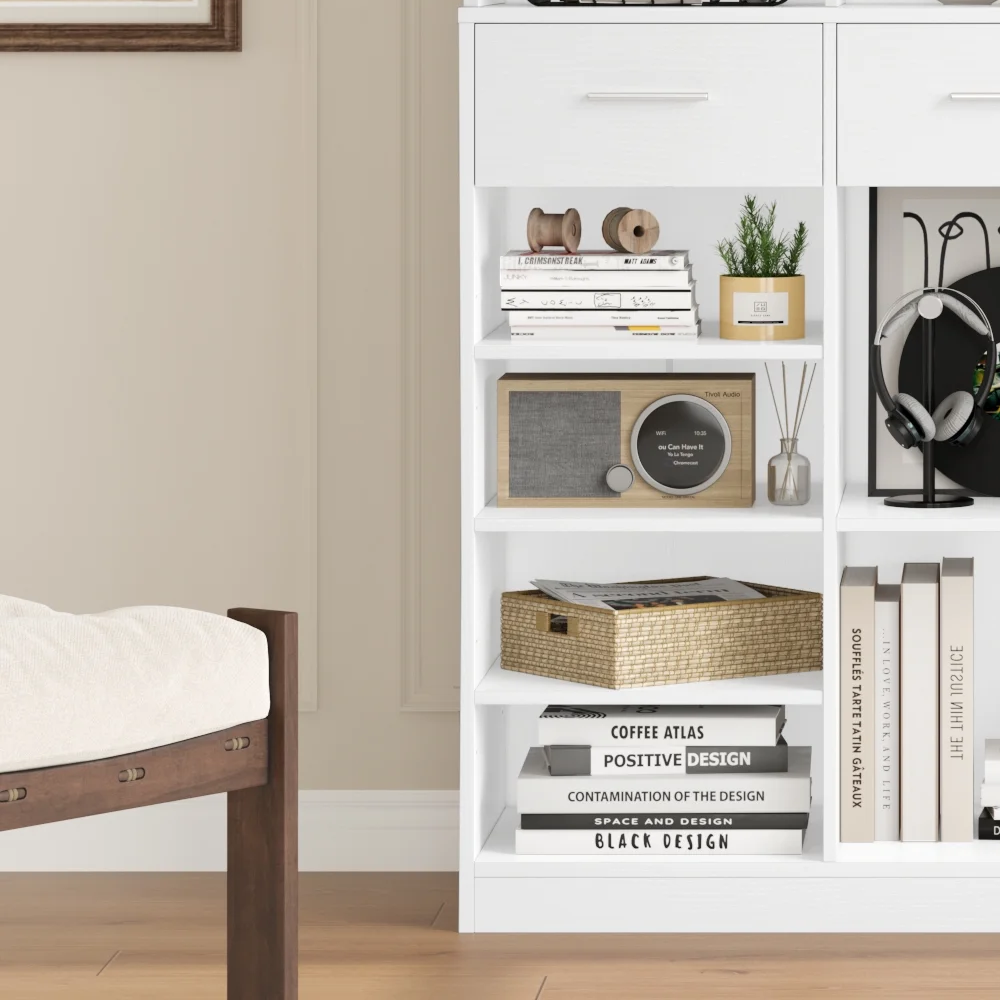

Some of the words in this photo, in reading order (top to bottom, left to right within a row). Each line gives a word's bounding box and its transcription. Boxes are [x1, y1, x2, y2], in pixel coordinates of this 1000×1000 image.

[852, 628, 865, 681] SOUFFLÉS
[852, 685, 862, 719] TARTE
[611, 725, 659, 739] COFFEE
[663, 725, 705, 739] ATLAS
[852, 720, 862, 753] TATIN
[603, 753, 682, 768] POSITIVE
[687, 752, 751, 767] DESIGN
[852, 758, 865, 808] GÂTEAUX
[568, 791, 671, 802] CONTAMINATION
[674, 791, 691, 802] OF
[693, 791, 717, 802] THE
[719, 791, 765, 802] DESIGN
[680, 818, 733, 826] DESIGN
[595, 832, 652, 849] BLACK
[663, 832, 729, 850] DESIGN
